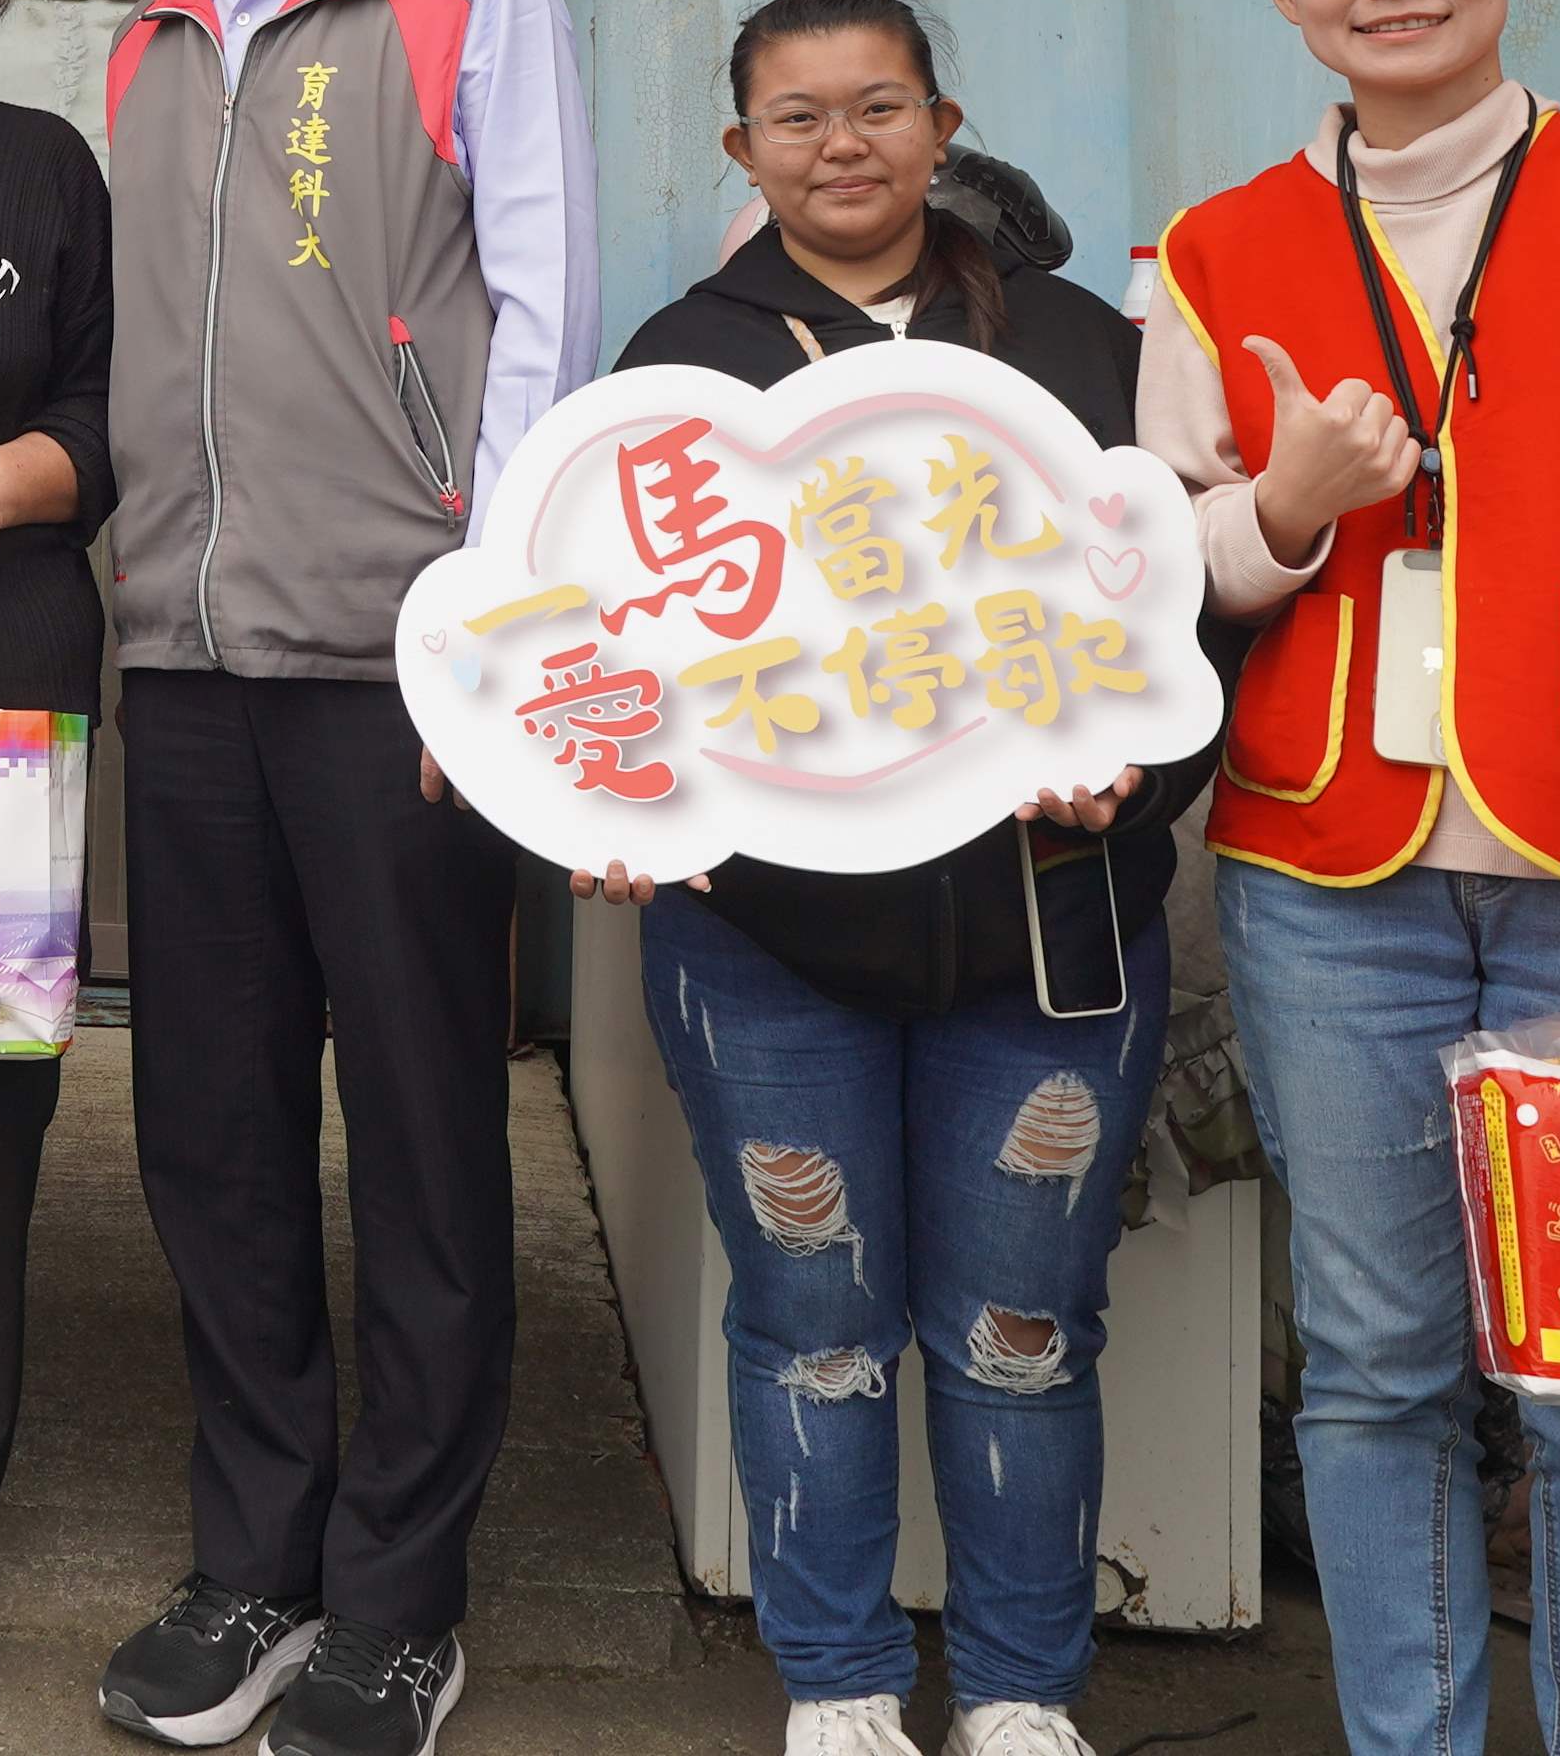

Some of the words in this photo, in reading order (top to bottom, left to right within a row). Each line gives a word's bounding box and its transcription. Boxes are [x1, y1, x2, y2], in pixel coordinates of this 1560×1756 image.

[285, 61, 339, 271] 育達科大
[463, 417, 1065, 641] 一馬當先
[514, 588, 1148, 802] 愛不停歇
